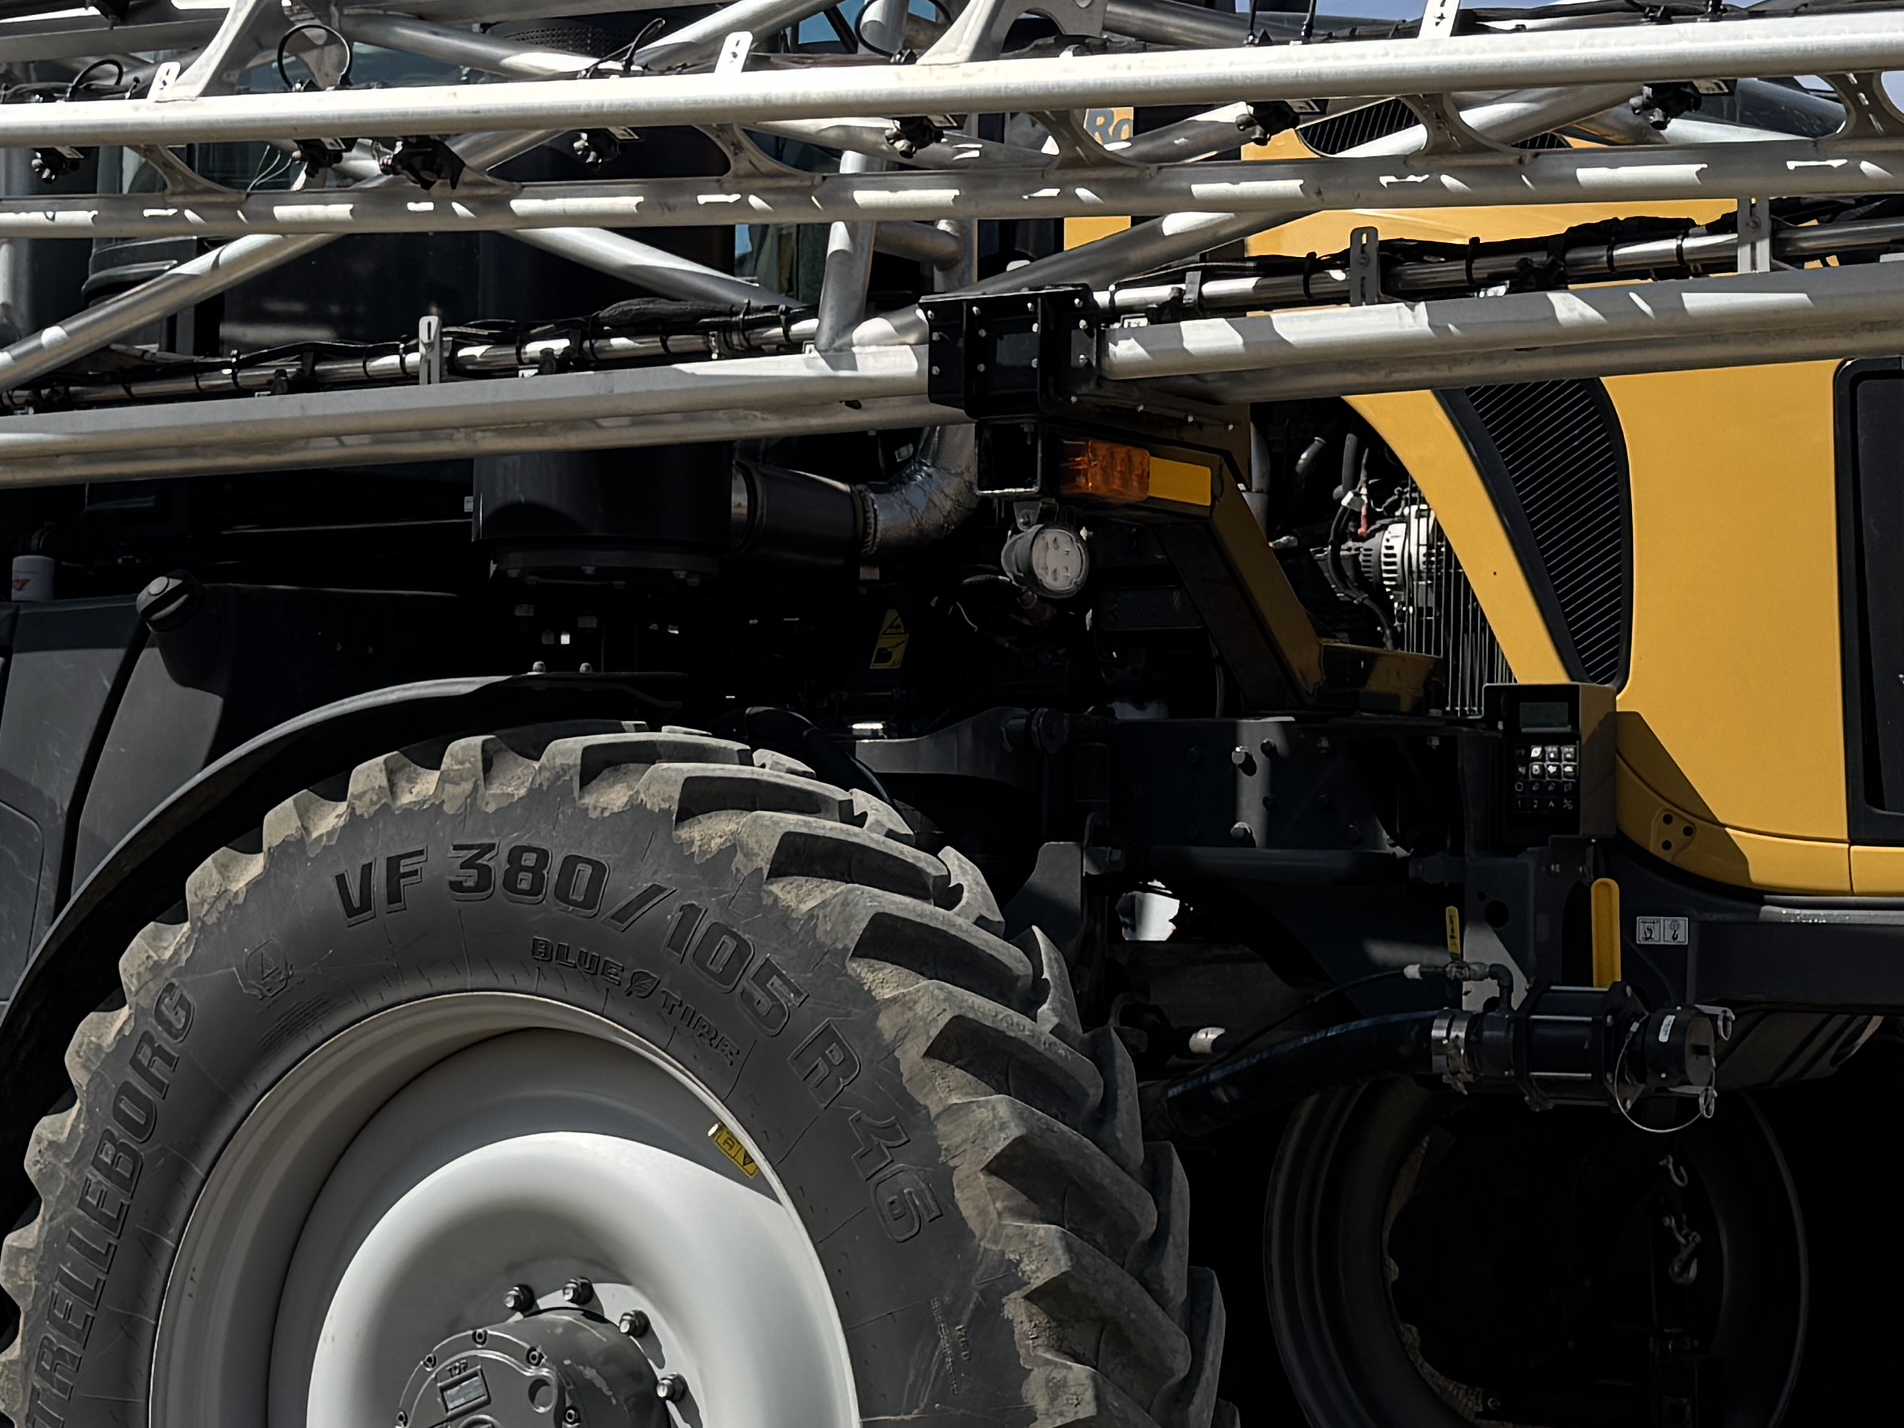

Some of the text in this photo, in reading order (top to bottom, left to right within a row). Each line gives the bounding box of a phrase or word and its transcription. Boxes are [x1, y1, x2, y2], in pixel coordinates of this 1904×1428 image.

[335, 839, 944, 1243] VF 380/105 R 46
[529, 936, 743, 1066] BLUE TIRE
